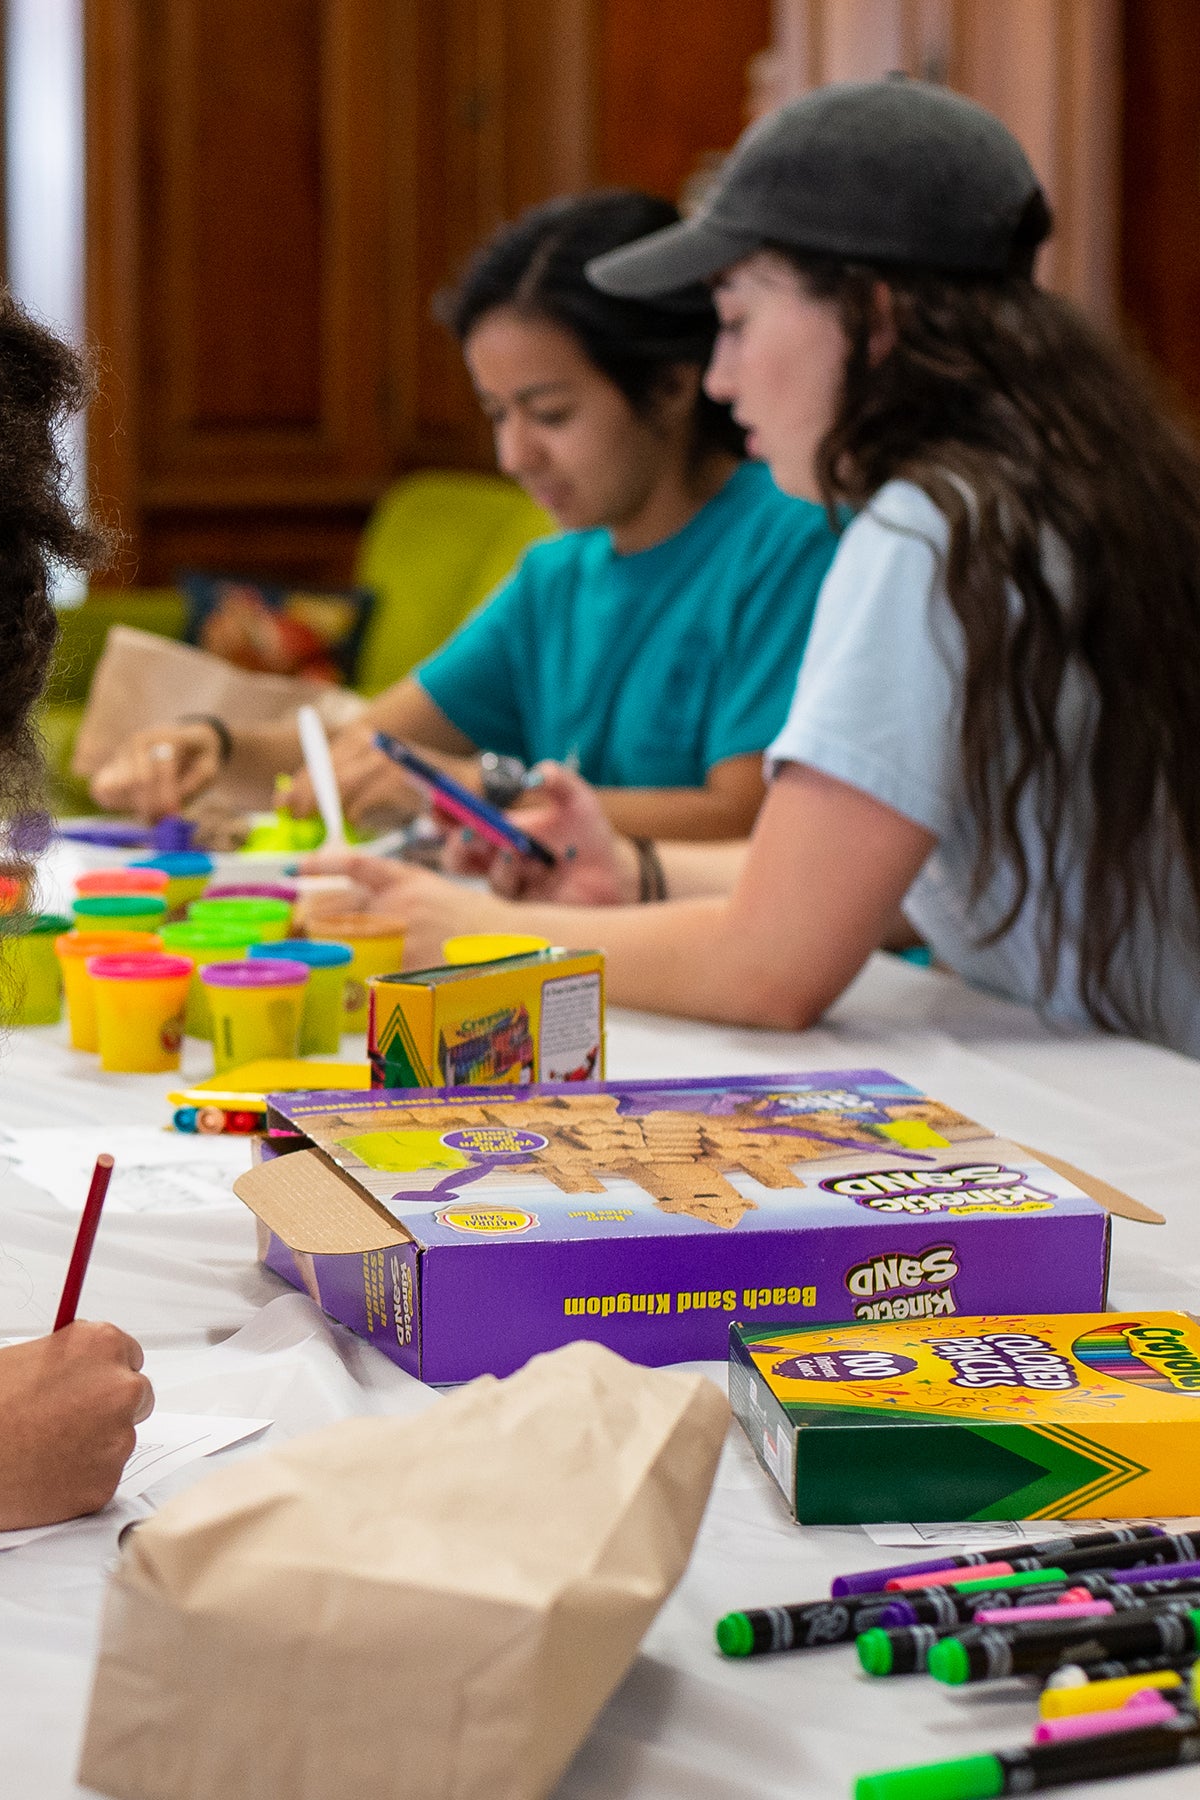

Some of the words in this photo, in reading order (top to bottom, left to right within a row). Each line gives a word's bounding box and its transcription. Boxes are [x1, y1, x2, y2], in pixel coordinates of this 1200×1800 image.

[869, 1184, 1050, 1214] Kinetic
[464, 1219, 518, 1227] NATURAL
[362, 1253, 374, 1333] ngdom
[563, 1293, 671, 1317] Kingdom
[676, 1290, 737, 1314] Sand
[742, 1286, 817, 1309] Beach
[837, 1352, 901, 1377] 100
[926, 1336, 1019, 1388] PENCILS
[982, 1333, 1074, 1390] COLORED
